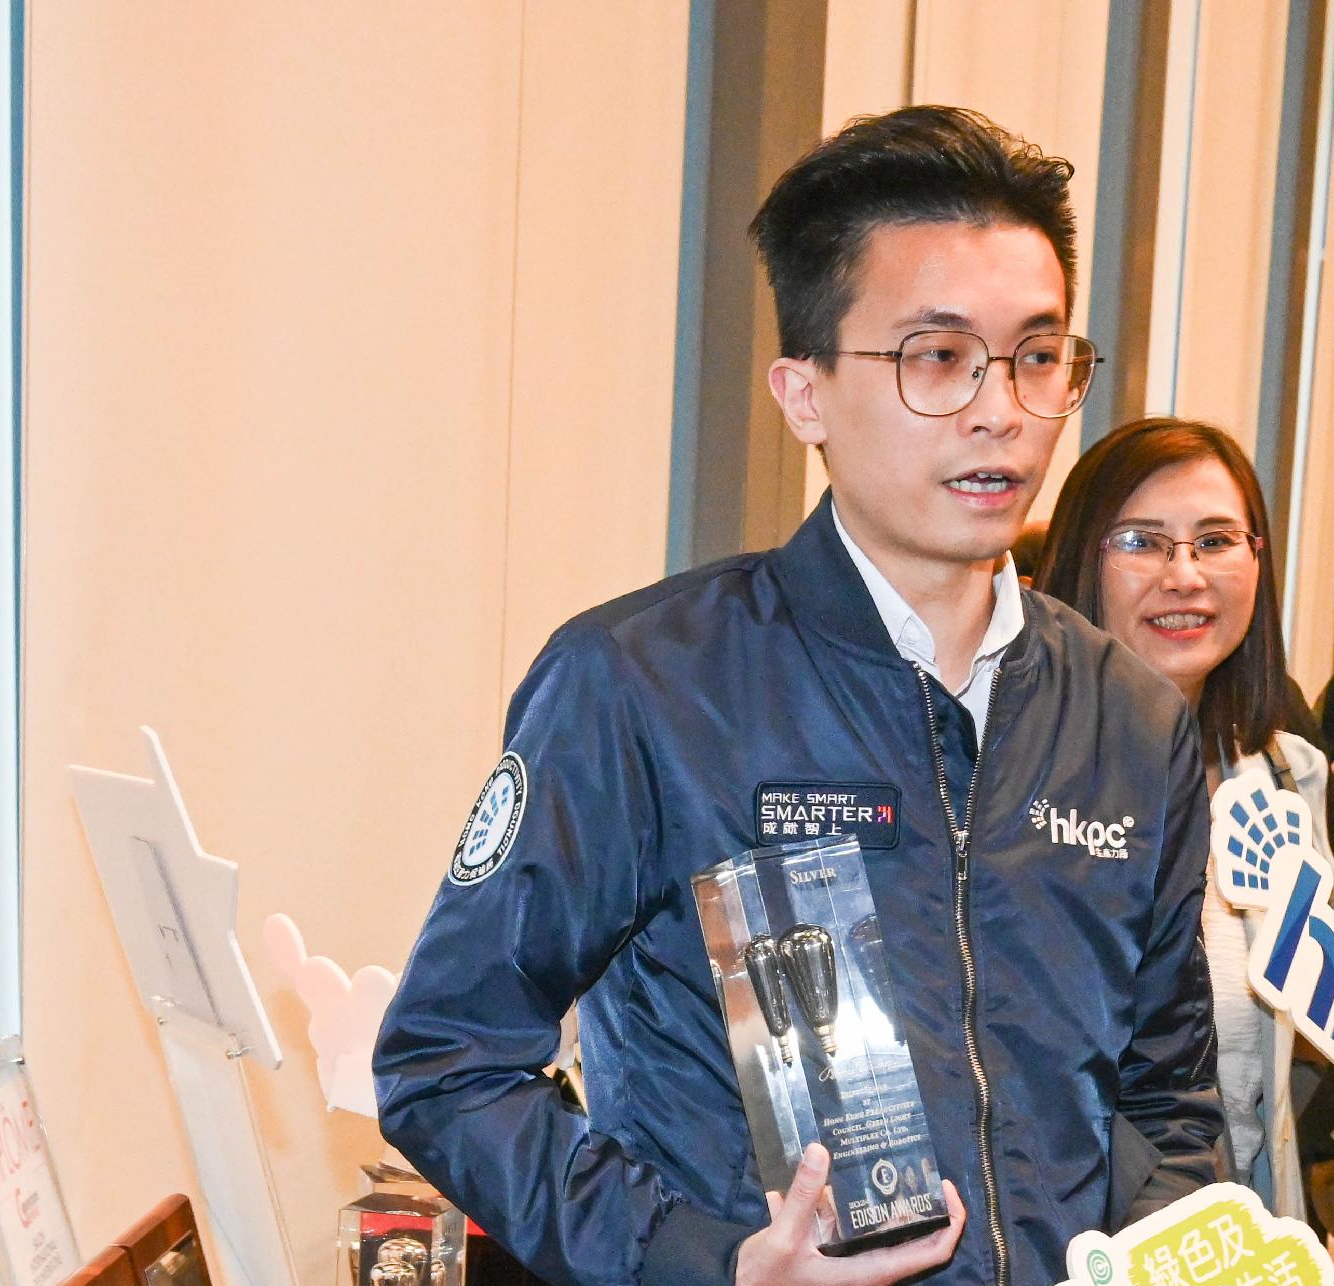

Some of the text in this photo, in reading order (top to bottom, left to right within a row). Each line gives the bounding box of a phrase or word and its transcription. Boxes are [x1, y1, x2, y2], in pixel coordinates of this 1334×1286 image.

[762, 793, 857, 805] MAKE SMART
[761, 805, 873, 822] SMARTER
[1050, 808, 1127, 856] hkpc
[850, 1193, 933, 1229] EDISON AWARDS
